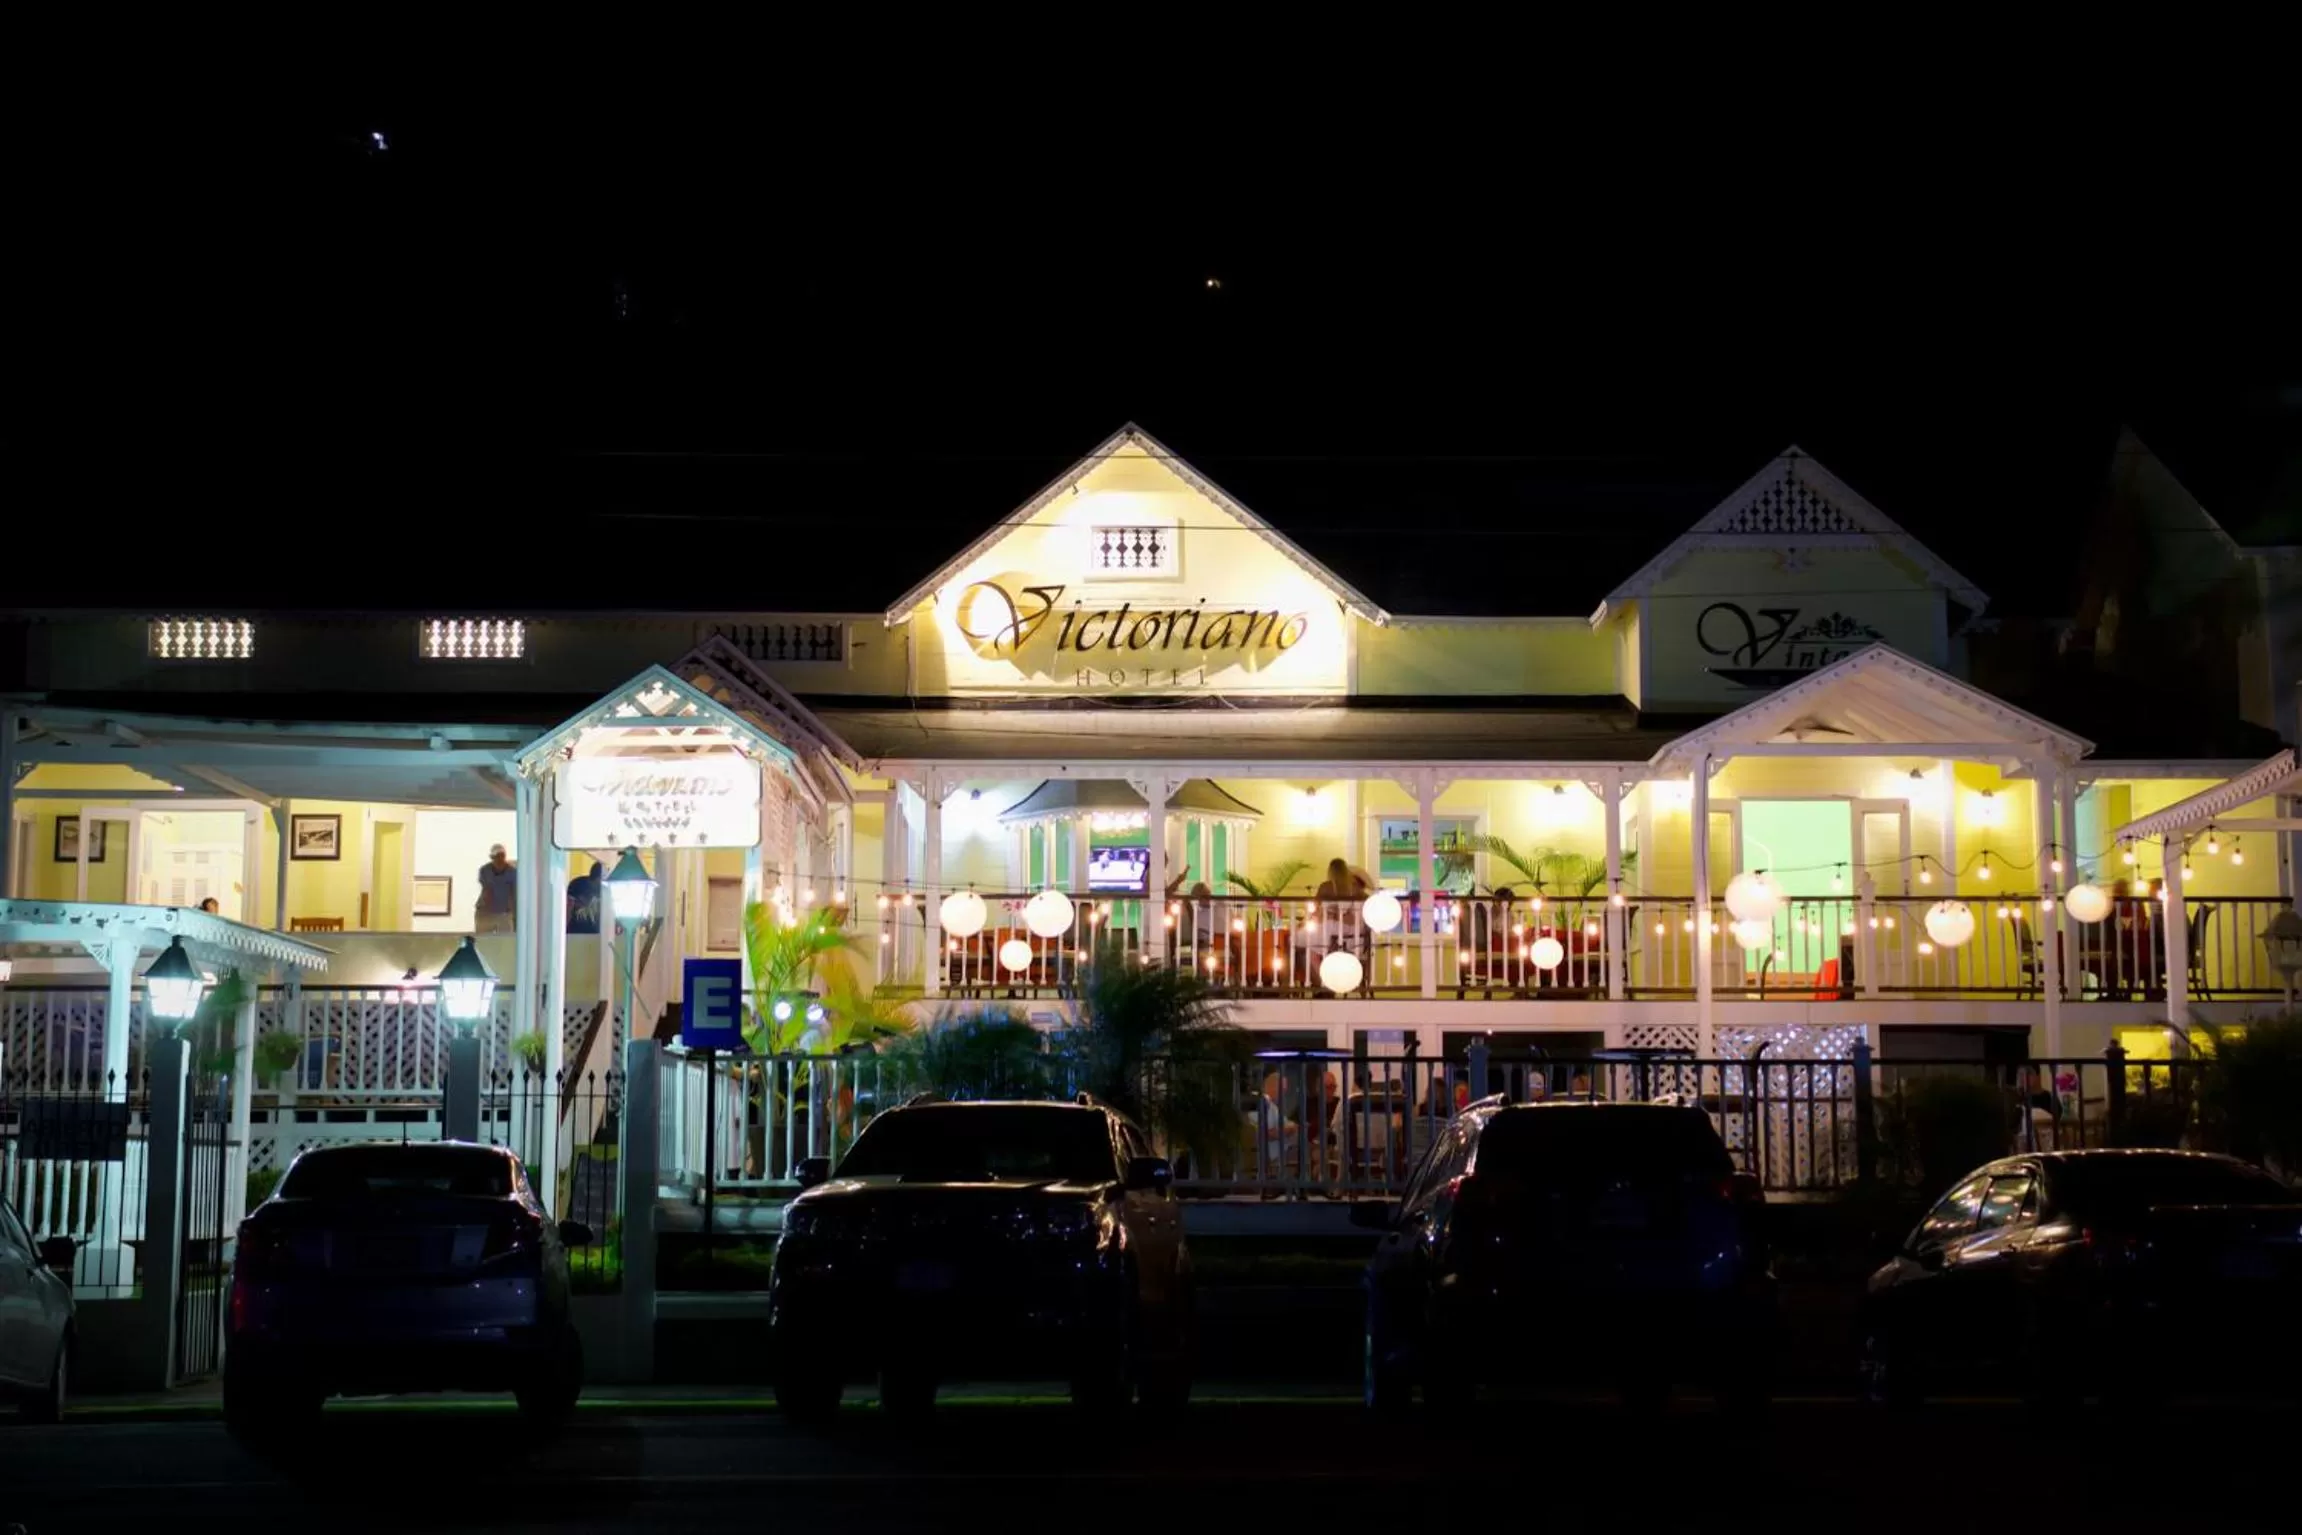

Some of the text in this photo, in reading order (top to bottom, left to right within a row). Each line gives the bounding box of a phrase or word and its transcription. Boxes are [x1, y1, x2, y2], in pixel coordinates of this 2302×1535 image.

[956, 581, 1308, 653] Victoriano
[1075, 668, 1209, 687] HOTEL
[692, 976, 733, 1029] E
